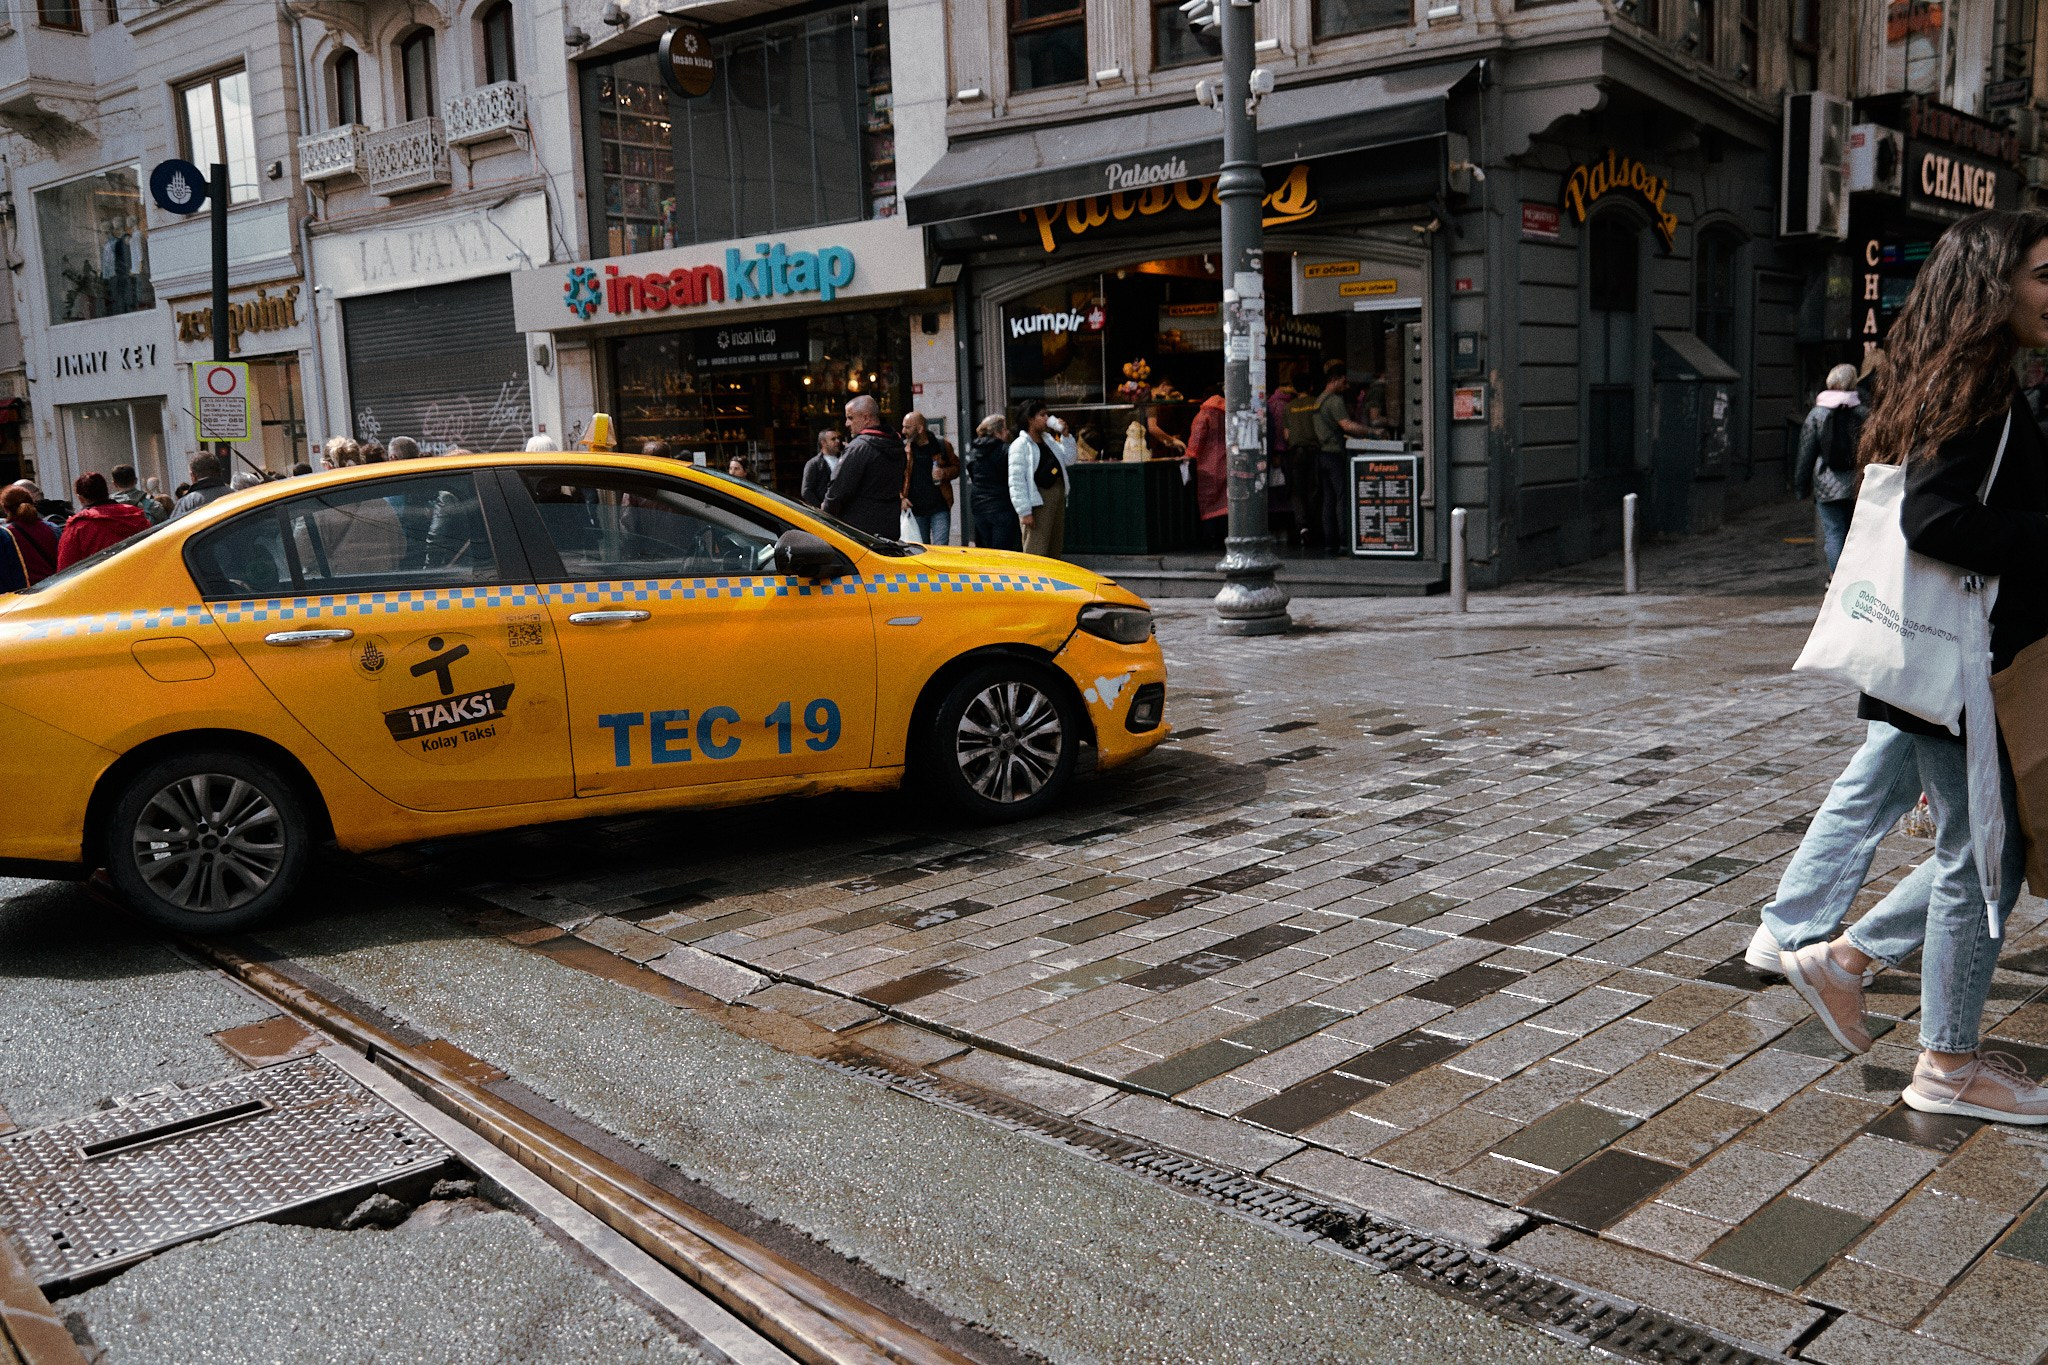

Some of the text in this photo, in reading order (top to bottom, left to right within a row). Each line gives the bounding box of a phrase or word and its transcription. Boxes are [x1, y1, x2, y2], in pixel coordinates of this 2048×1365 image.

[1105, 155, 1188, 190] Patsosis
[1921, 152, 1996, 210] CHANGE
[1565, 148, 1679, 252] Patsosis
[1010, 307, 1085, 339] kumpir
[55, 343, 156, 379] JIMMY KEY
[408, 692, 496, 732] iTAKSi
[421, 723, 497, 753] Kolay Taksi
[598, 697, 843, 768] TEC 19
